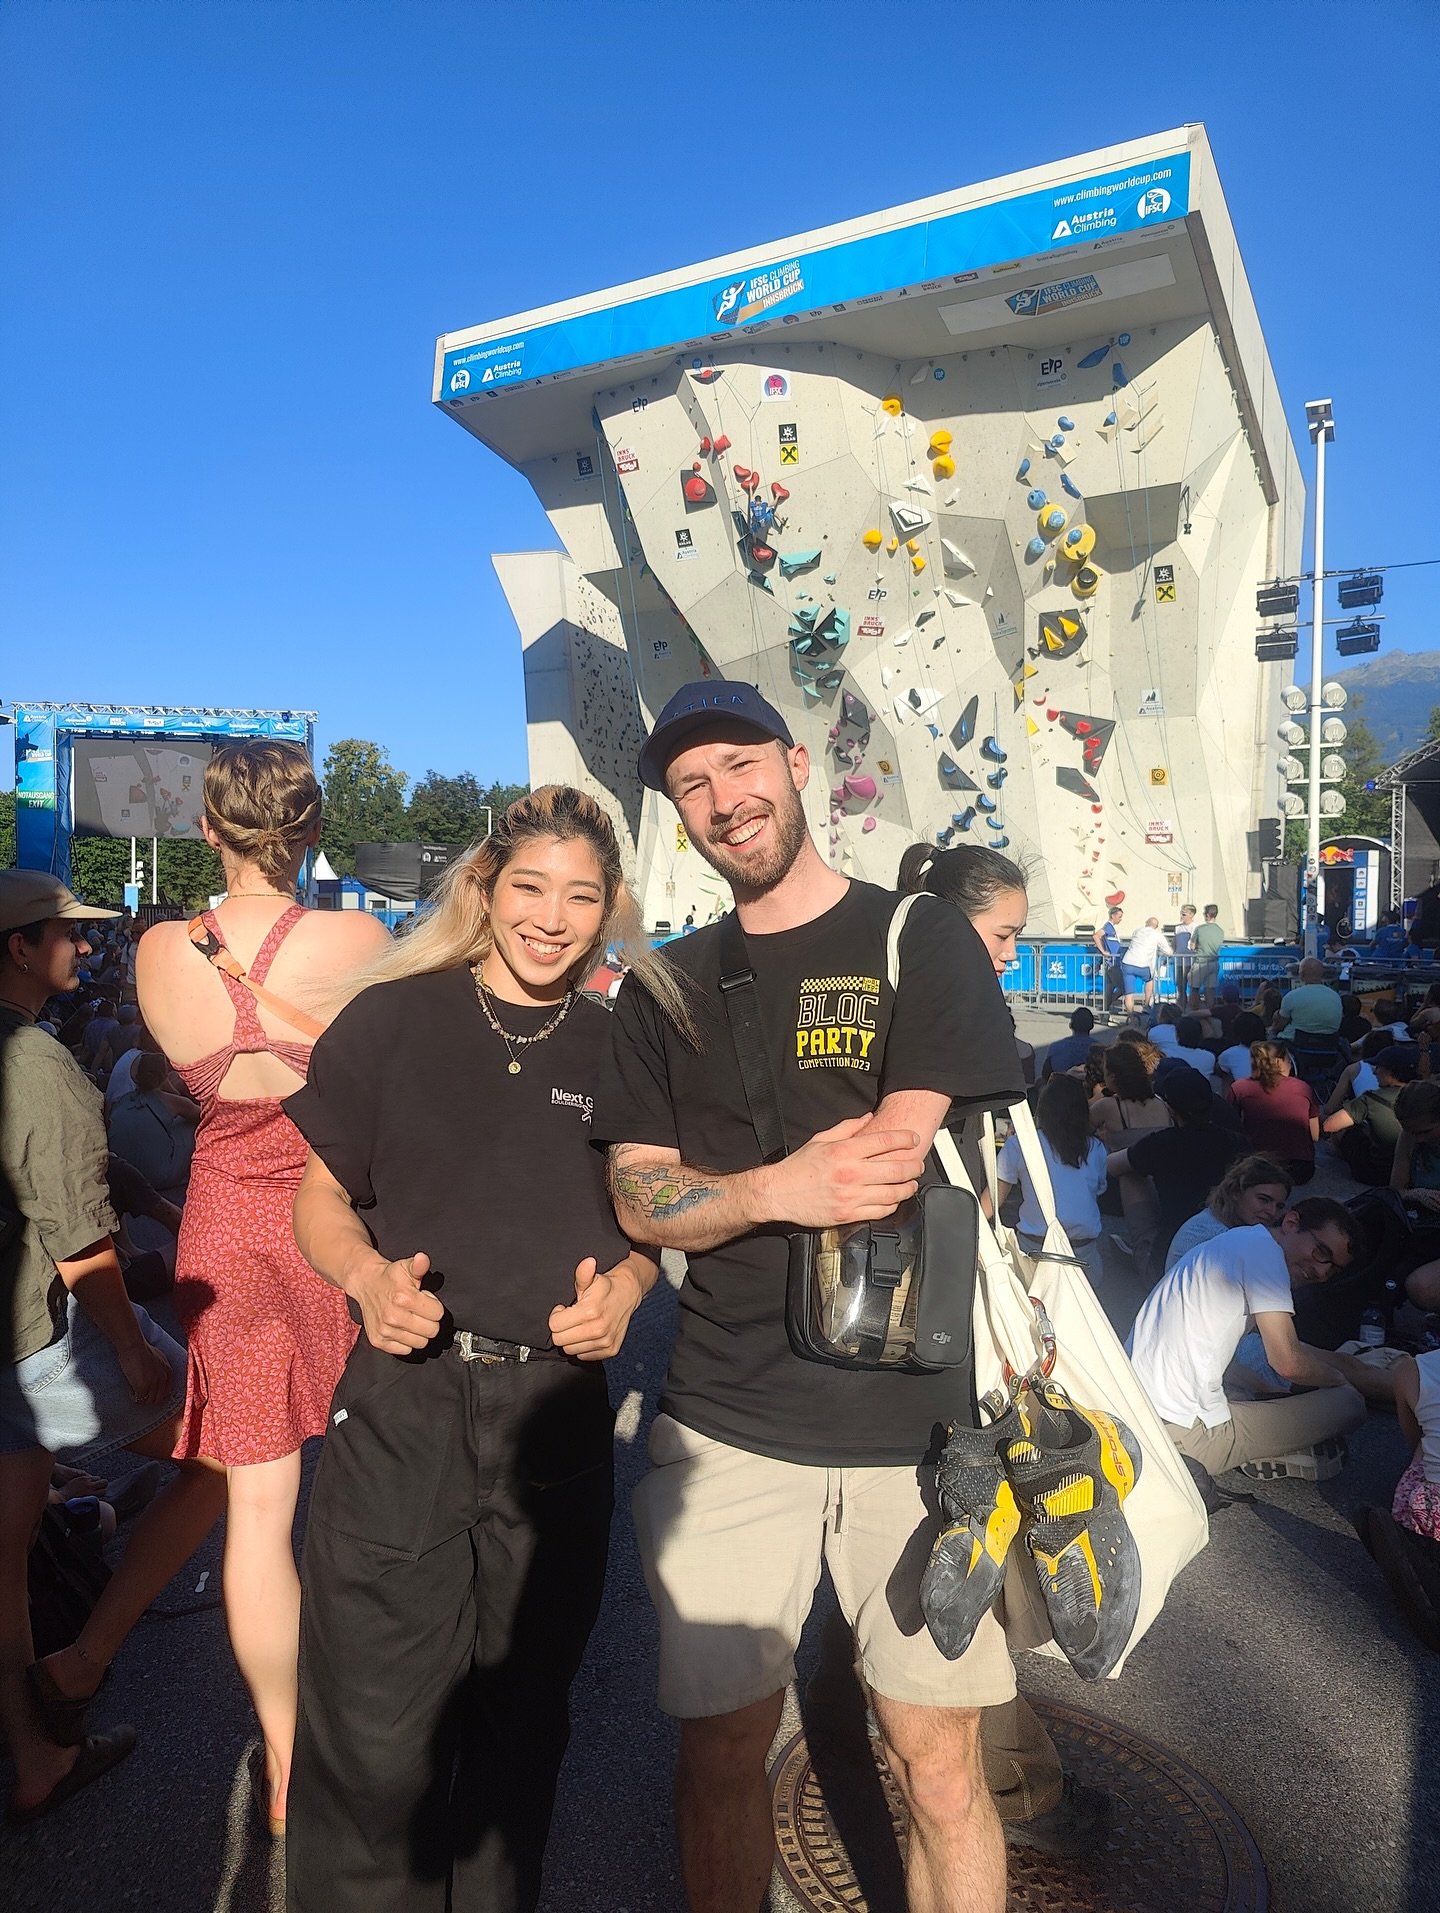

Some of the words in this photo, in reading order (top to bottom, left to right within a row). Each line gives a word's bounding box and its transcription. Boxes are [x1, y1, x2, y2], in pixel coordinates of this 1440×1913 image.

[1053, 168, 1172, 208] www.climbingworldcup.com
[1071, 207, 1115, 226] Austria
[1145, 202, 1163, 215] IFSC
[1074, 217, 1117, 234] Climbing
[750, 274, 768, 290] IFSC
[770, 260, 800, 281] CLIMBING
[746, 278, 781, 304] WORLD
[782, 268, 801, 286] CUP
[763, 279, 805, 309] INNSBRUCK
[1042, 288, 1077, 304] WORLD
[1078, 281, 1097, 293] CUP
[493, 360, 521, 373] Austria
[494, 367, 522, 379] Climbing
[769, 386, 784, 396] IFSC
[28, 799, 45, 808] EXIT
[797, 992, 880, 1029] BLOC
[796, 1026, 876, 1057] PARTY
[798, 1057, 850, 1070] COMPETITION
[551, 1087, 584, 1104] Next
